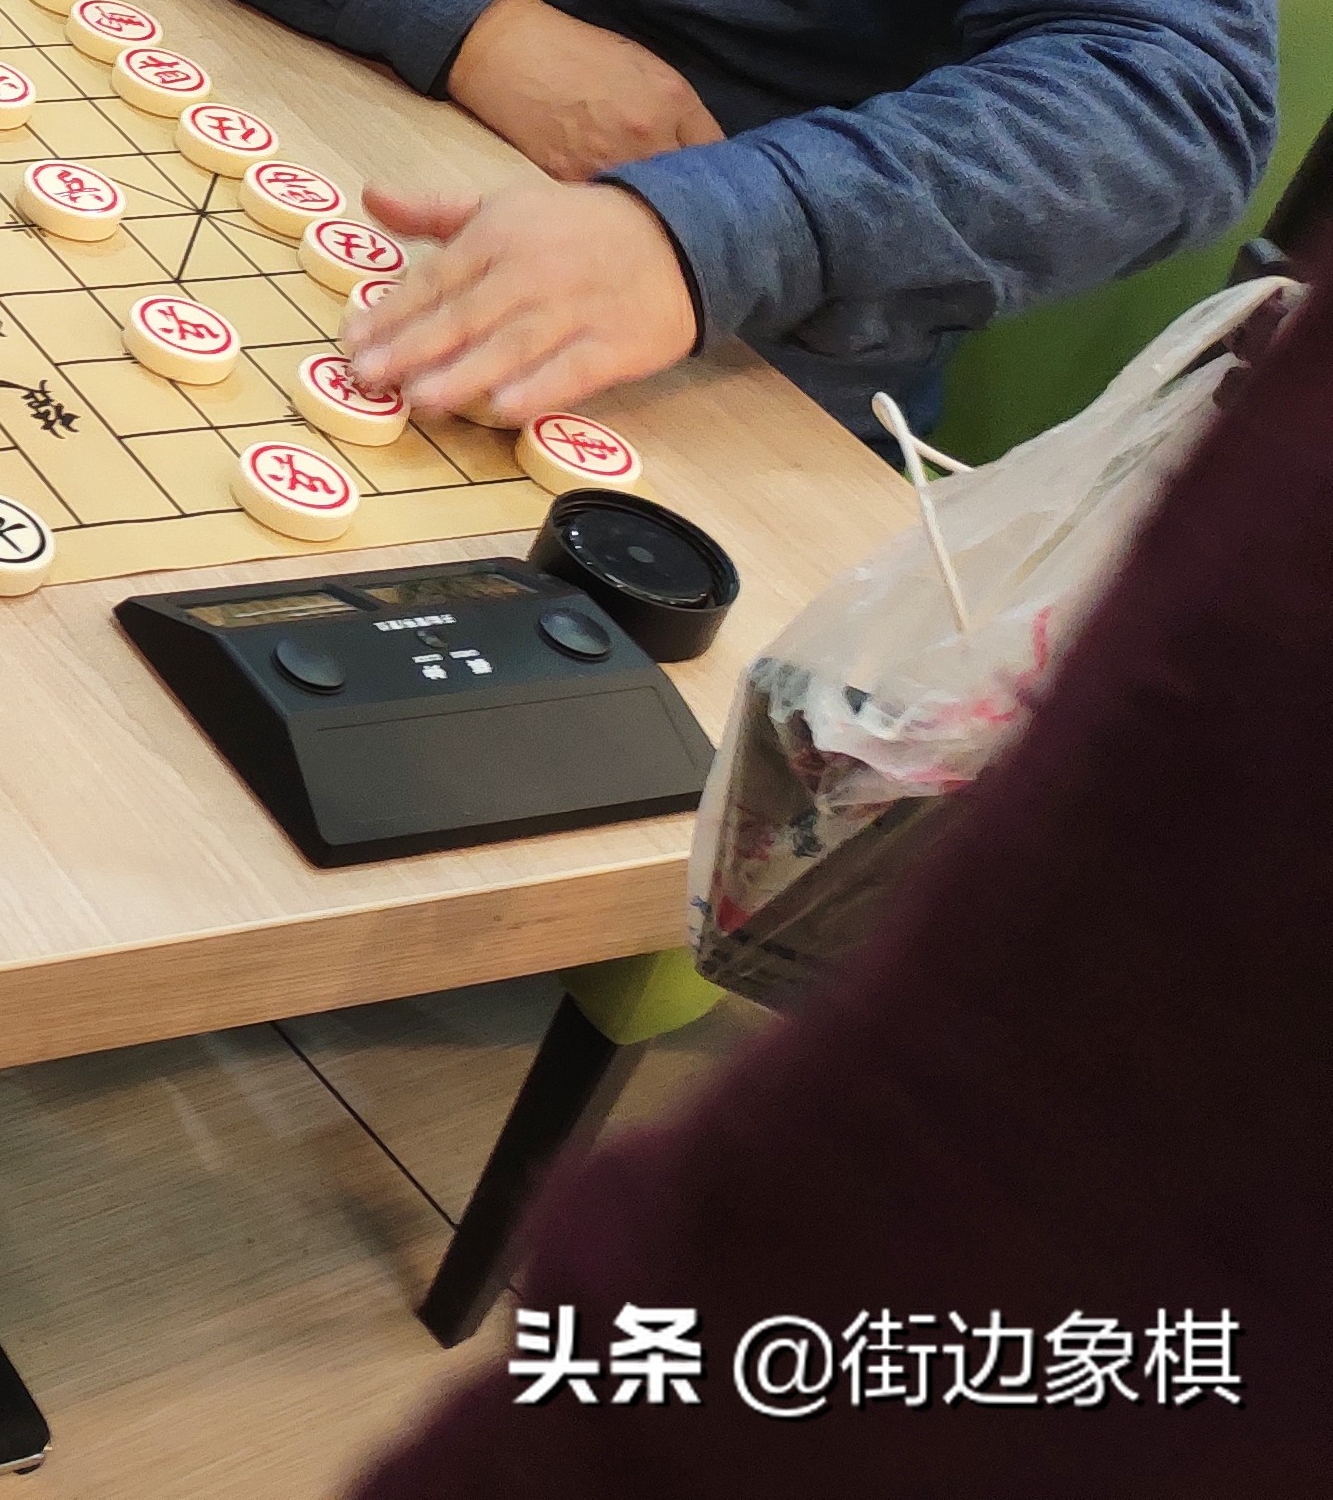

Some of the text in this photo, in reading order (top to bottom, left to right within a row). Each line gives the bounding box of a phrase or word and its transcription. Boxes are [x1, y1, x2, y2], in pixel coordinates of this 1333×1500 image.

[139, 60, 194, 85] 相
[204, 115, 256, 142] 仕
[331, 232, 384, 263] 仕
